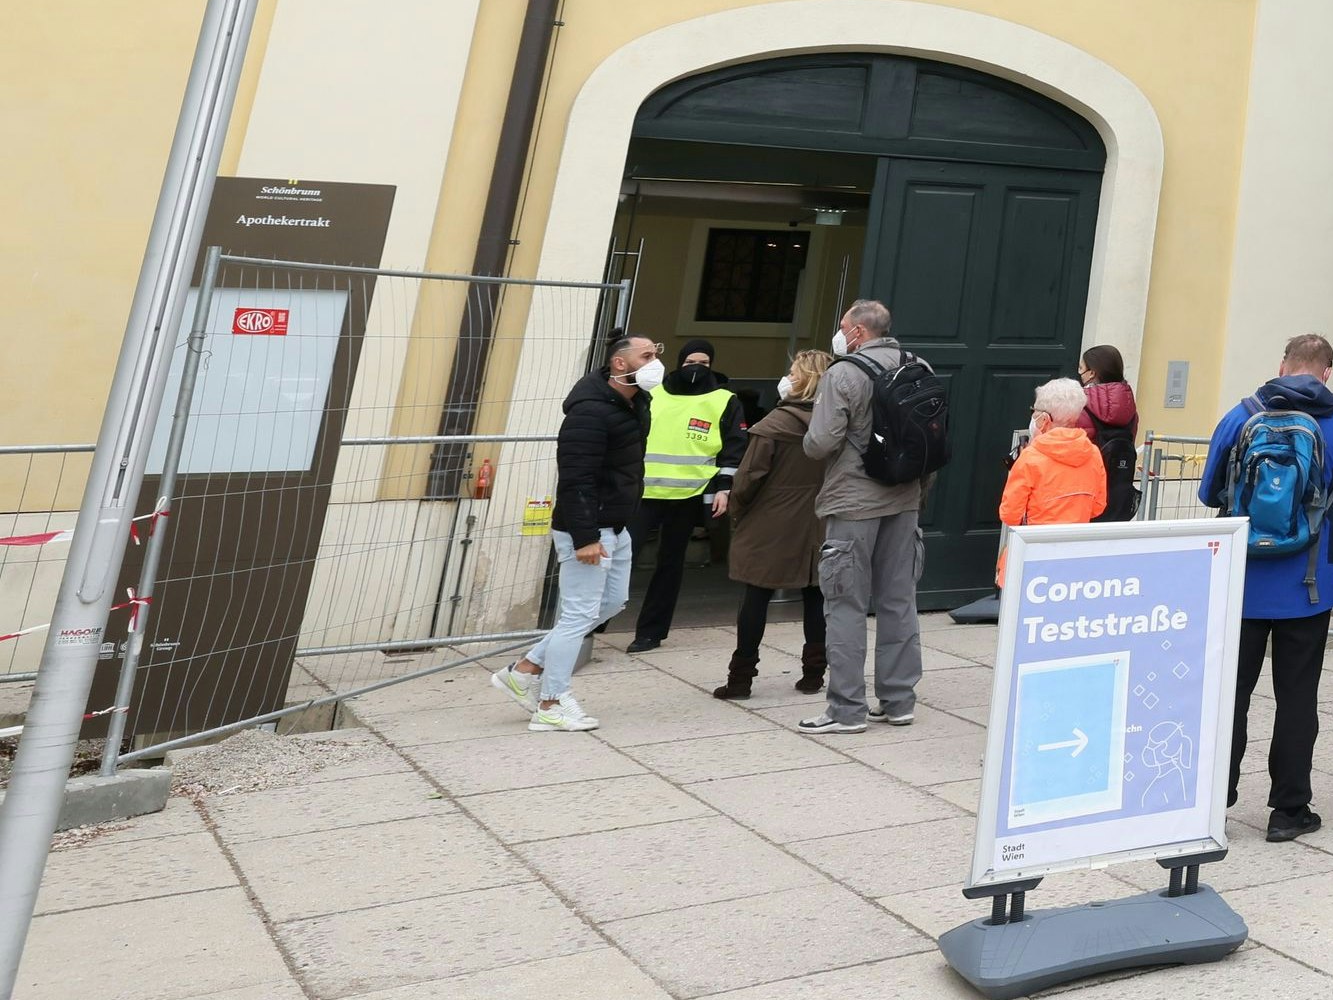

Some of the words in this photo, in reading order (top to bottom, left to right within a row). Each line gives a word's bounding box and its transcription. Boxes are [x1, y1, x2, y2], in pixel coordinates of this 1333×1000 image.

[260, 186, 321, 197] Schönbrunn
[236, 214, 331, 227] Apothekertrakt
[239, 312, 271, 331] EKRO
[1026, 576, 1141, 604] Corona
[1023, 604, 1189, 644] Teststraße
[61, 628, 91, 636] HAGO
[1002, 843, 1025, 853] Stadt
[1002, 852, 1025, 862] Wien
